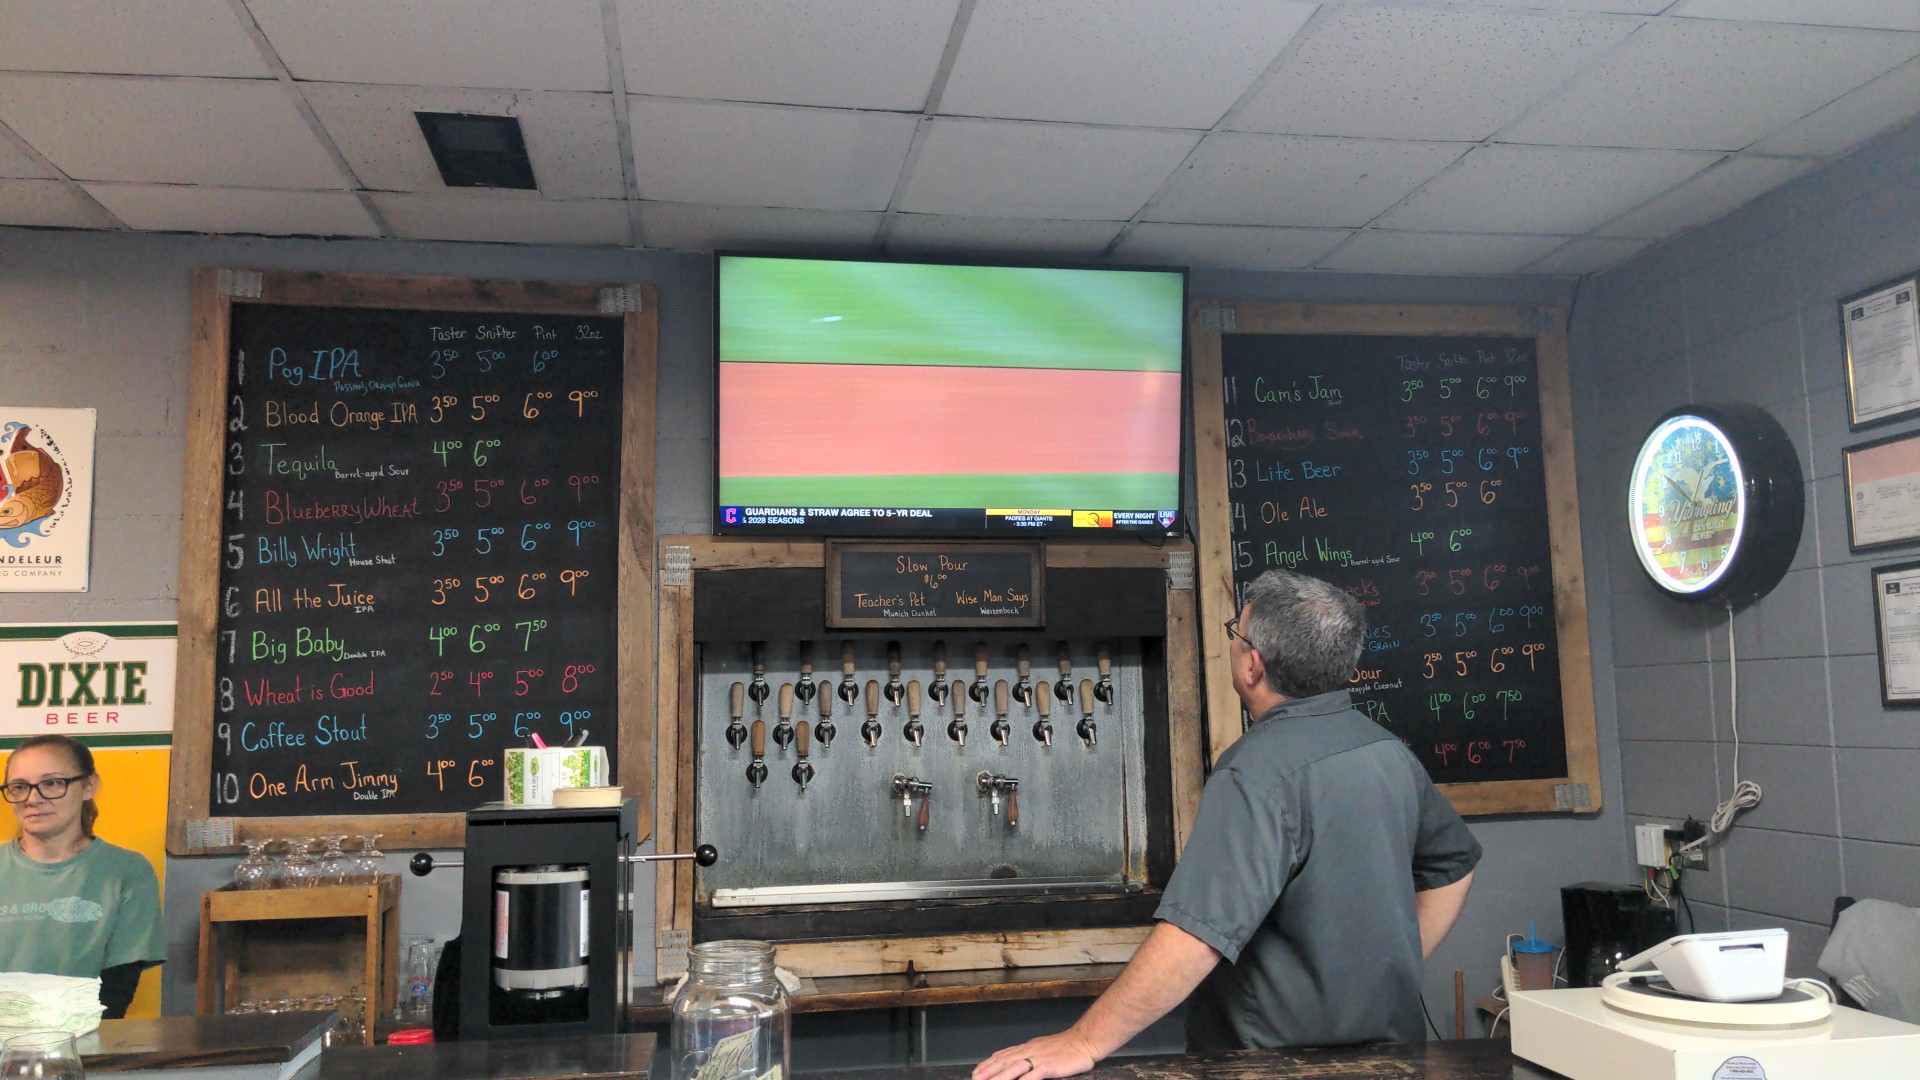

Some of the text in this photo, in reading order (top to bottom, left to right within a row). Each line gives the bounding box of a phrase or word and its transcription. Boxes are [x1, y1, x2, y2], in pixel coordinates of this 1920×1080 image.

[430, 327, 467, 341] Taster
[476, 326, 517, 340] Snifter
[534, 326, 557, 339] Pint
[239, 348, 361, 385] 1 Pog IPA
[1224, 376, 1236, 404] 11
[1255, 377, 1300, 402] Cam's
[1308, 375, 1342, 400] Jam
[230, 395, 248, 432] 2
[267, 401, 319, 427] Blood
[331, 401, 385, 430] Orange
[391, 402, 418, 423] IPA
[1225, 419, 1246, 447] 12
[230, 443, 245, 475] 3
[261, 443, 338, 480] Tequila
[335, 465, 409, 480] Barrel-aged Sour
[1228, 459, 1246, 488] 13
[1257, 460, 1294, 481] Lite
[1301, 461, 1341, 479] Beer
[227, 490, 243, 520] 4
[745, 508, 797, 516] GUARDIANS
[1229, 502, 1246, 533] 14
[1261, 502, 1289, 524] Ole
[1300, 497, 1328, 519] Ale
[1659, 505, 1664, 517] 9
[228, 534, 245, 569] 5
[259, 536, 296, 567] Billy
[302, 533, 356, 566] Wright
[1233, 536, 1352, 570] 15 Angel Wings
[1666, 534, 1671, 545] 8
[350, 554, 395, 567] House Stout
[897, 555, 969, 573] Slow Pour
[1386, 555, 1400, 563] Sour
[1702, 557, 1708, 570] 6
[225, 586, 240, 618] 6
[256, 588, 281, 613] All
[294, 588, 321, 609] the
[328, 584, 374, 608] Juice
[854, 592, 925, 608] Teacher's Pet
[956, 588, 1029, 608] Wise Man Says
[884, 608, 937, 618] Munich Dunkel
[222, 627, 344, 664] 7 Big Baby
[16, 661, 148, 708] DIXIE
[220, 670, 374, 712] 8 Wheat is Good
[1374, 678, 1402, 690] Coconut
[47, 712, 119, 725] BEER
[218, 714, 367, 755] 9 Coffee Stout
[216, 761, 397, 804] 10 One Arm Jimmy
[354, 791, 378, 800] Double
